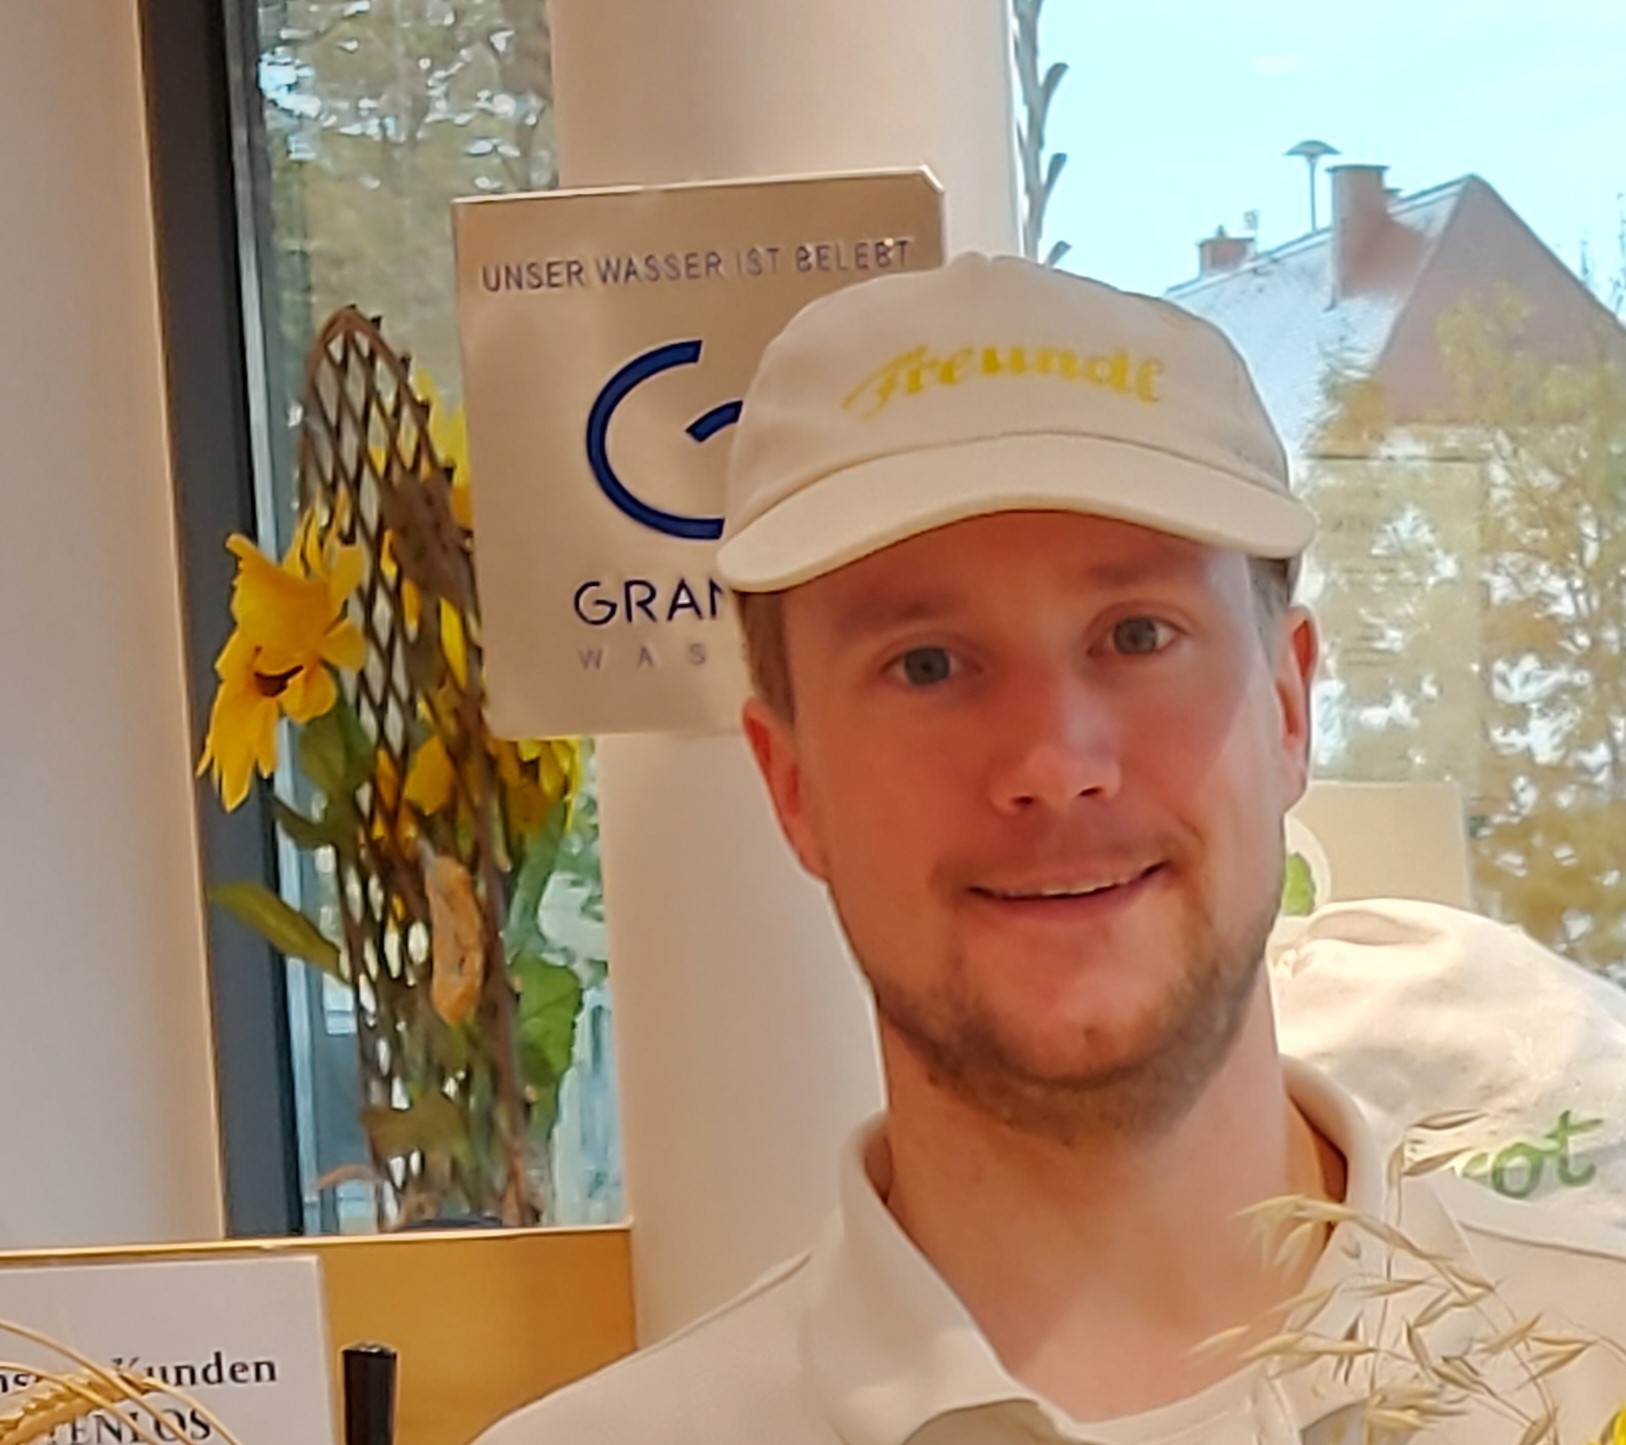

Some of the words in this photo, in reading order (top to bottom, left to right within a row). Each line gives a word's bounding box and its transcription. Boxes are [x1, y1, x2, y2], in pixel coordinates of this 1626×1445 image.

[482, 259, 585, 292] UNSER
[599, 251, 722, 284] WASSER
[736, 247, 781, 276] IST
[795, 239, 911, 271] BELEBT
